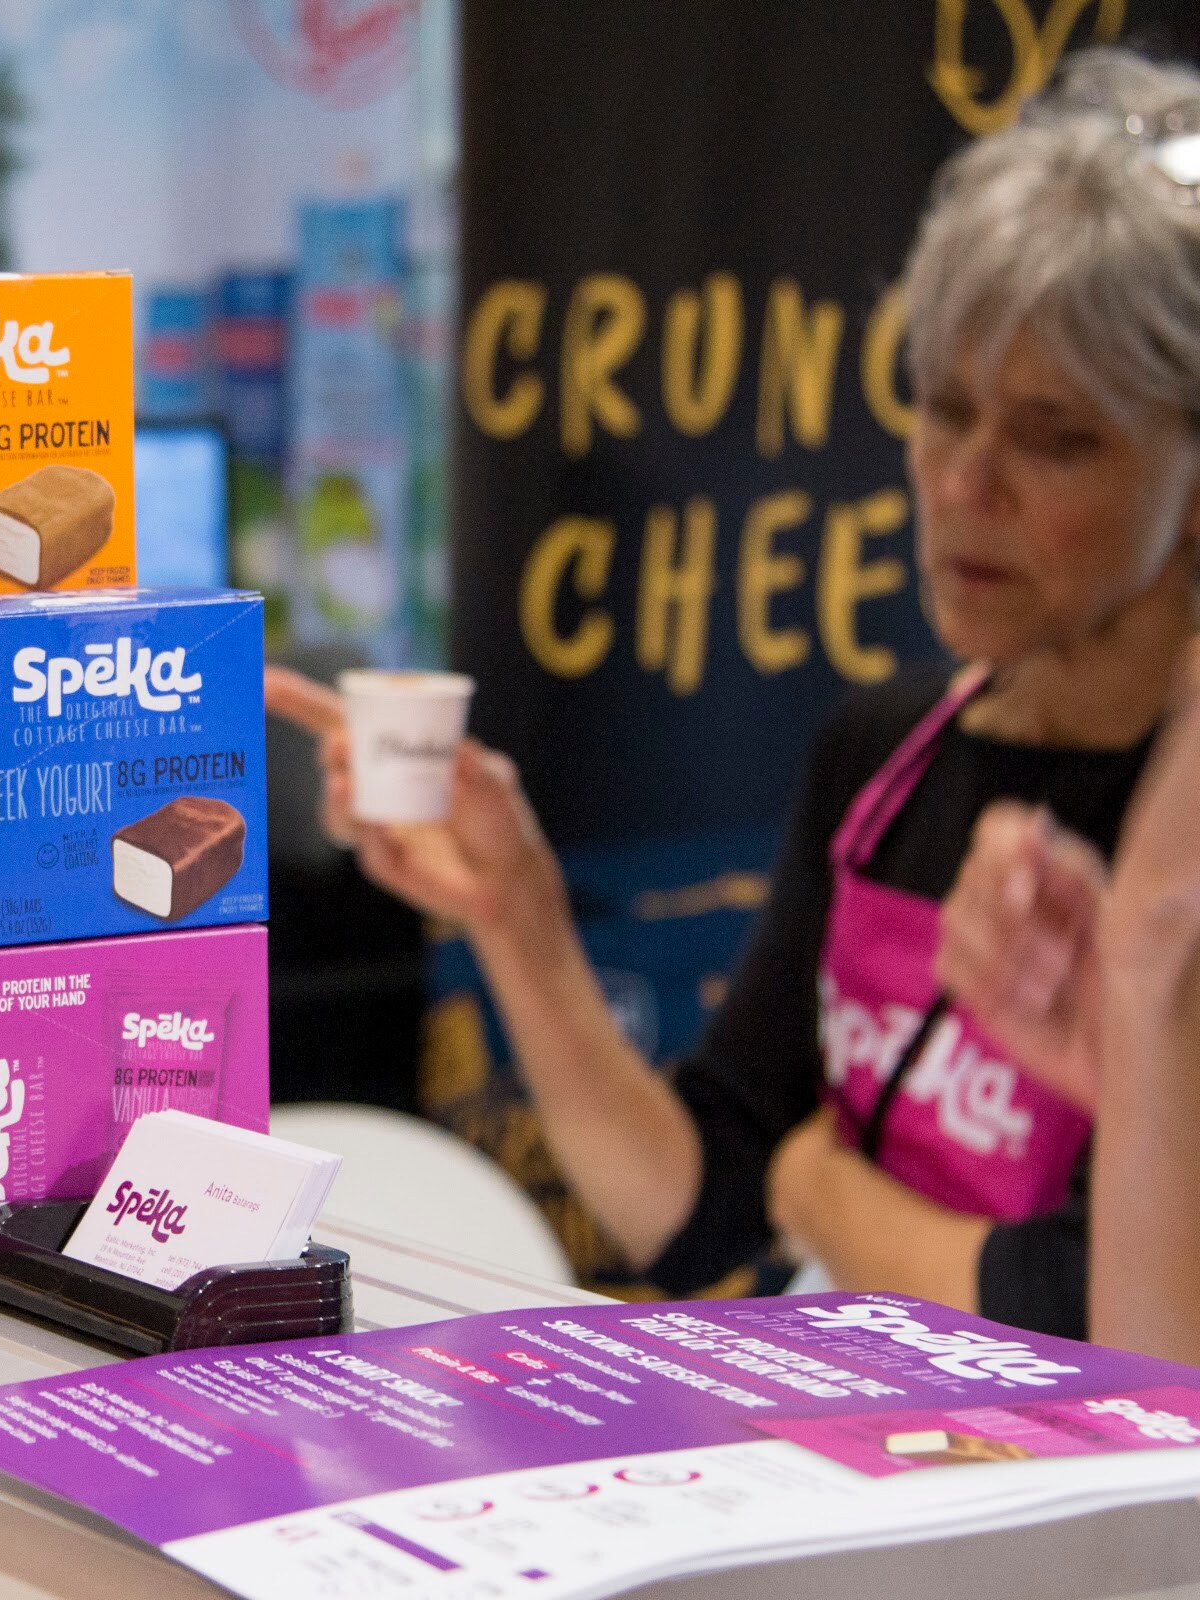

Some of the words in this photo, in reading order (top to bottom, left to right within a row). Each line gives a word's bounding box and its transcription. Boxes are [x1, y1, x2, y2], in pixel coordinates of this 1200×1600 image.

[20, 420, 110, 450] PROTEIN
[19, 706, 41, 724] THE
[66, 699, 135, 721] ORIGINAL
[13, 724, 85, 747] COTTAGE
[95, 718, 150, 740] CHEESE
[117, 758, 146, 788] 8G
[154, 750, 246, 785] PROTEIN
[36, 761, 114, 818] YOGURT
[2, 978, 52, 996] PROTEIN
[54, 976, 66, 990] IN
[69, 974, 91, 989] THE
[0, 998, 13, 1012] OF
[18, 994, 50, 1009] YOUR
[52, 991, 86, 1007] HAND
[138, 1068, 198, 1087] PROTEIN
[205, 1181, 233, 1202] Anita
[106, 1180, 189, 1244] Spēka
[543, 1320, 644, 1357] SNACKING
[325, 1356, 404, 1381] SMART
[621, 1318, 697, 1341] PALM
[712, 1350, 799, 1375] YOUR
[768, 1373, 850, 1397] HAND
[724, 1338, 834, 1372] PROTEIN
[842, 1379, 906, 1397] THE
